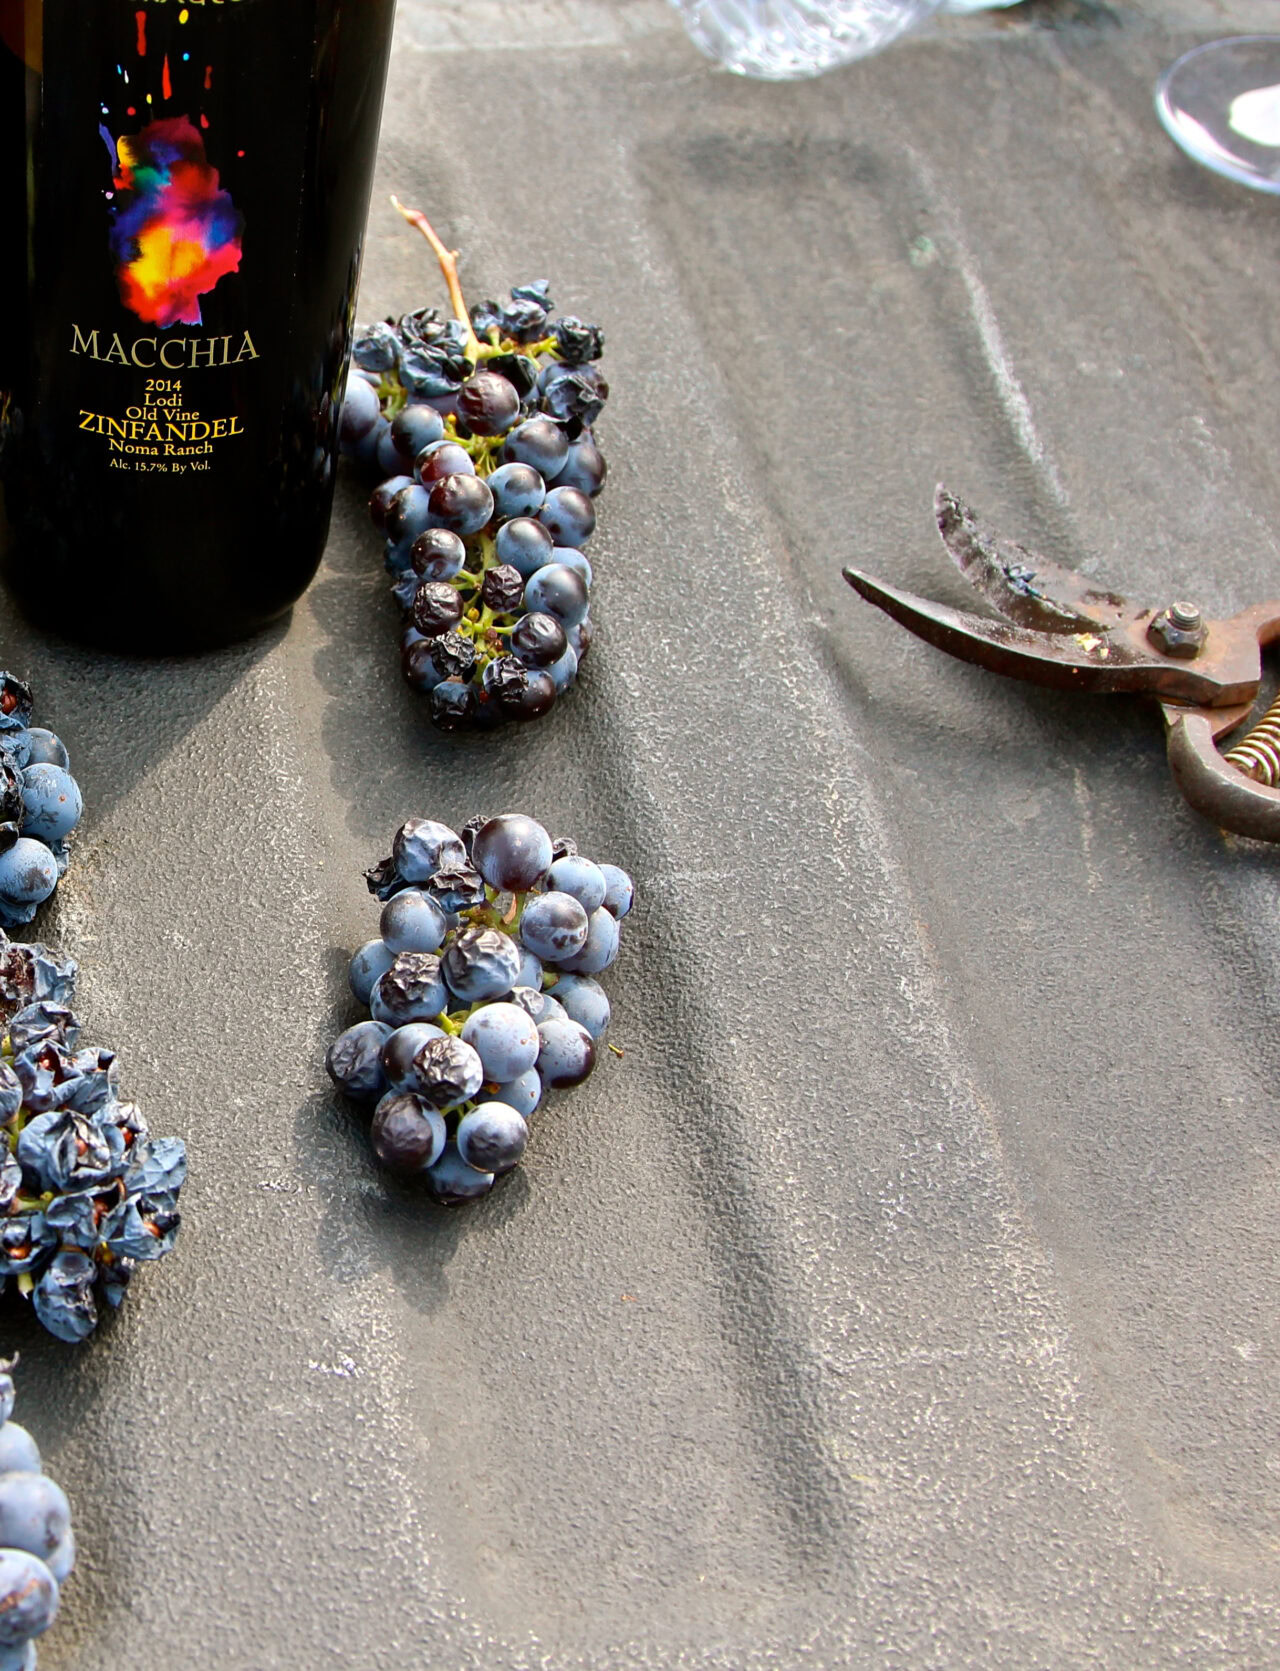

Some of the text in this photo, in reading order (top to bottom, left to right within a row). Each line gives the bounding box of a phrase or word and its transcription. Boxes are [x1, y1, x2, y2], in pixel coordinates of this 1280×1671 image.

[70, 323, 260, 369] MACCHIA
[145, 379, 182, 391] 2014
[144, 393, 182, 406] Lodi
[125, 406, 200, 421] Old Vine
[79, 409, 244, 441] ZINFANDEL
[108, 437, 213, 456] Noma Ranch
[109, 458, 211, 474] Alc. 15.7% By Vol.
